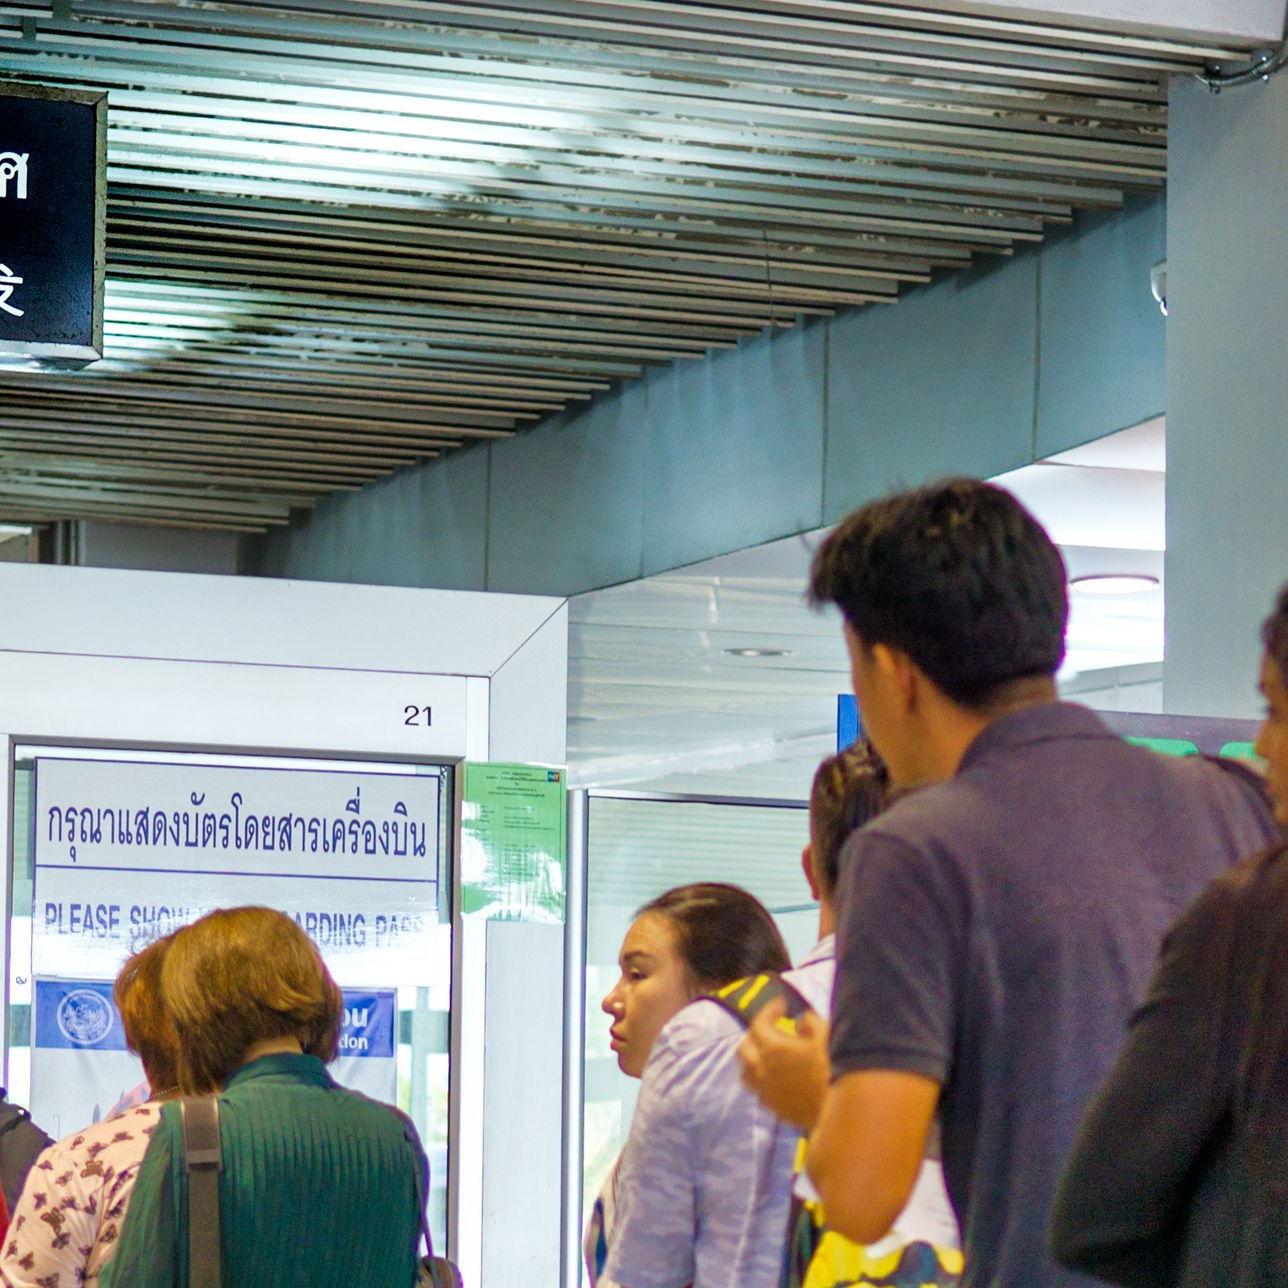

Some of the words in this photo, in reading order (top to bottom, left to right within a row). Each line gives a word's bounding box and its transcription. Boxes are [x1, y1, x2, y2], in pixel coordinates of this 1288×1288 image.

[404, 705, 433, 727] 21
[47, 785, 428, 863] กรุณาแสดงบัตรโดยสารเครื่องบิน
[44, 902, 121, 939] PLEASE
